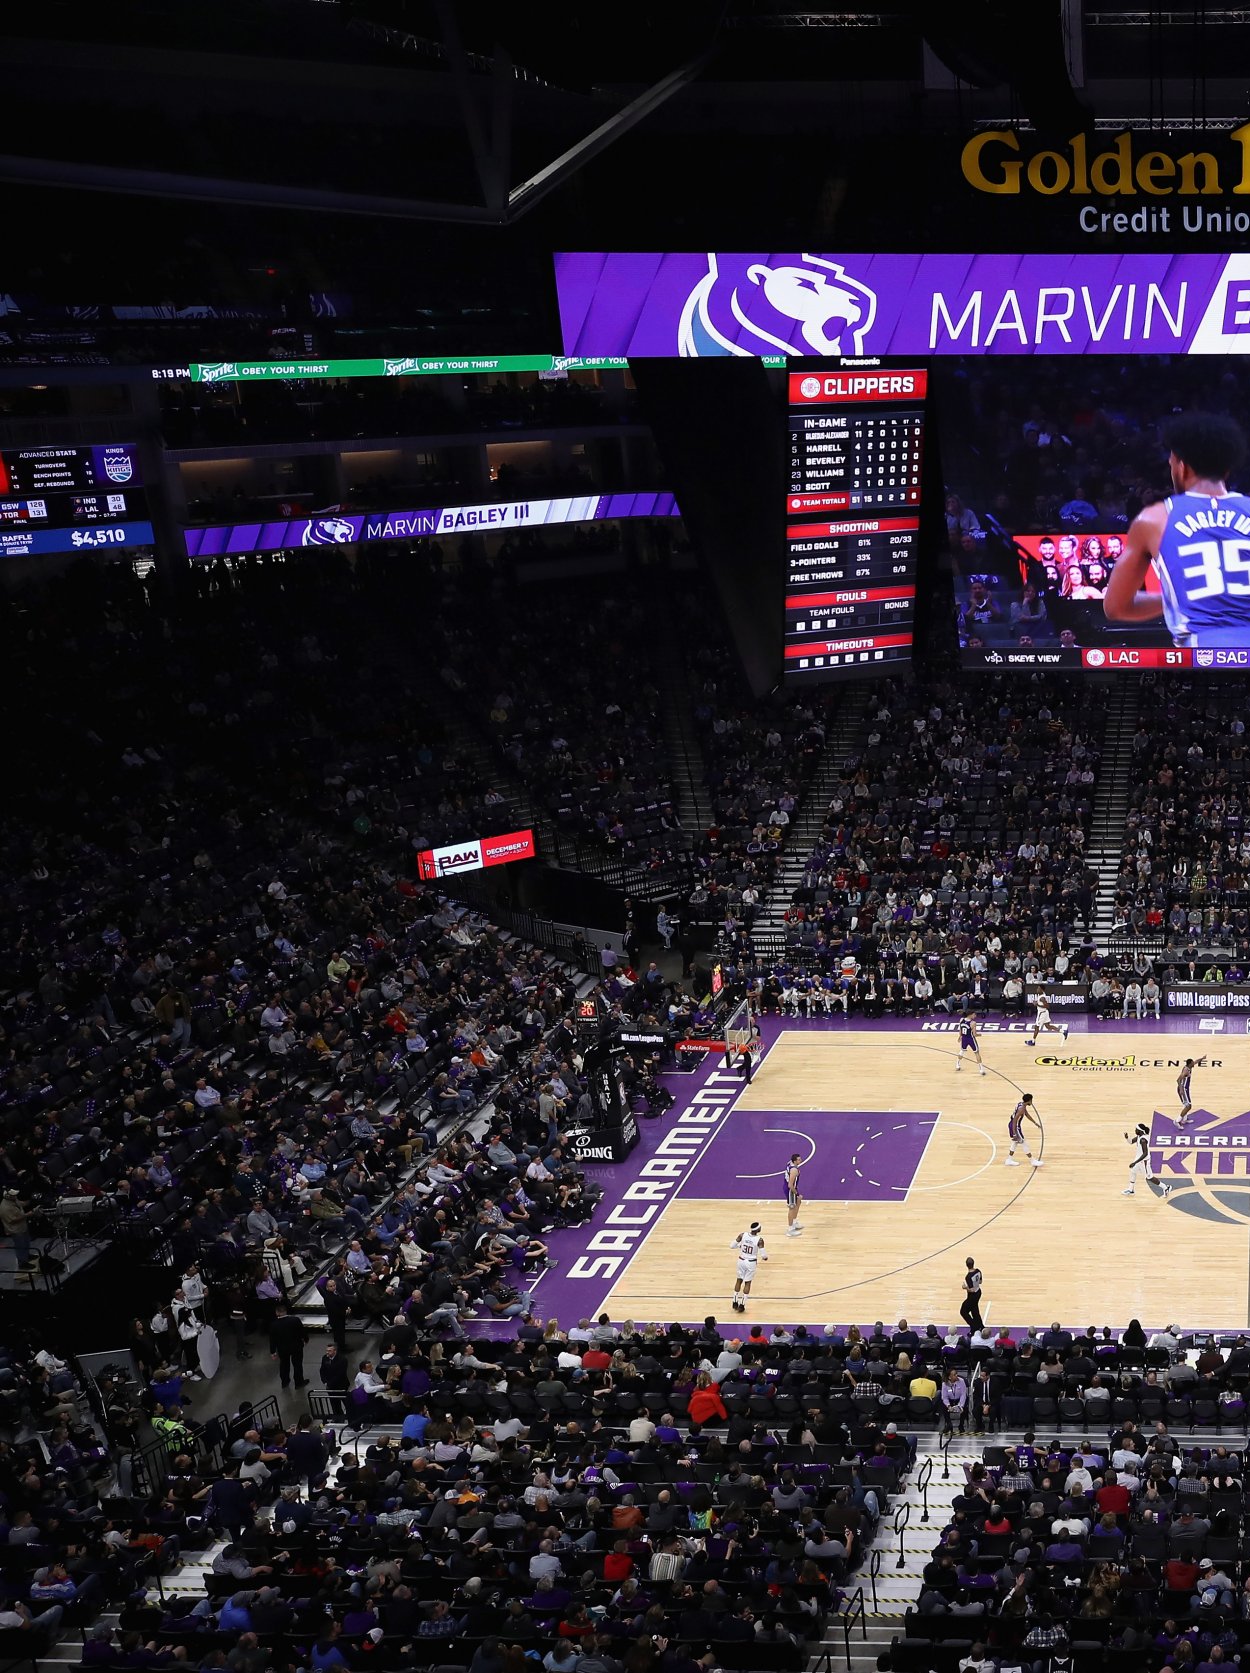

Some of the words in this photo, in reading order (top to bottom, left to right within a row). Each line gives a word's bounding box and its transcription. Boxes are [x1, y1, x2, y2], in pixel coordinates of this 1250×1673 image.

[1079, 206, 1170, 233] Credit
[928, 282, 1188, 348] MARVIN
[387, 358, 415, 375] Sprite
[471, 360, 498, 368] THIRST
[840, 358, 880, 366] Panasonic
[176, 369, 190, 377] PM
[202, 363, 234, 381] Sprite
[242, 367, 267, 375] OBEY
[270, 366, 295, 374] YOUR
[298, 365, 329, 373] THIRST
[824, 377, 914, 395] CLIPPERS
[805, 418, 847, 428] IN-GAME
[806, 444, 842, 452] HARRELL
[806, 457, 846, 465] BEVERLEY
[806, 469, 844, 478] WILLIAMS
[367, 516, 434, 539] MARVIN
[443, 507, 508, 528] BAGLEY
[514, 505, 529, 519] III
[830, 522, 879, 533] SHOOTING
[2, 534, 32, 542] RAFFLE
[71, 529, 125, 546] $4,510
[791, 544, 812, 552] FIELD
[814, 542, 839, 550] GOALS
[790, 557, 836, 566] 3-POINTERS
[790, 574, 809, 582] FREE
[811, 571, 843, 580] THROWS
[836, 592, 867, 602] FOULS
[885, 601, 909, 609] BONUS
[810, 609, 829, 617] TEAM
[831, 606, 854, 615] FOULS
[826, 639, 873, 651] TIMEOUTS
[1109, 652, 1139, 663] LAC
[1166, 652, 1182, 663] 51
[1217, 652, 1248, 663] SAC
[486, 843, 521, 855] DECEMBER
[1176, 994, 1192, 1006] NBA
[1193, 994, 1224, 1009] League
[1225, 994, 1250, 1007] Pass
[1034, 1055, 1136, 1067] Golden1
[742, 1245, 753, 1254] 30
[1019, 1459, 1028, 1467] 15
